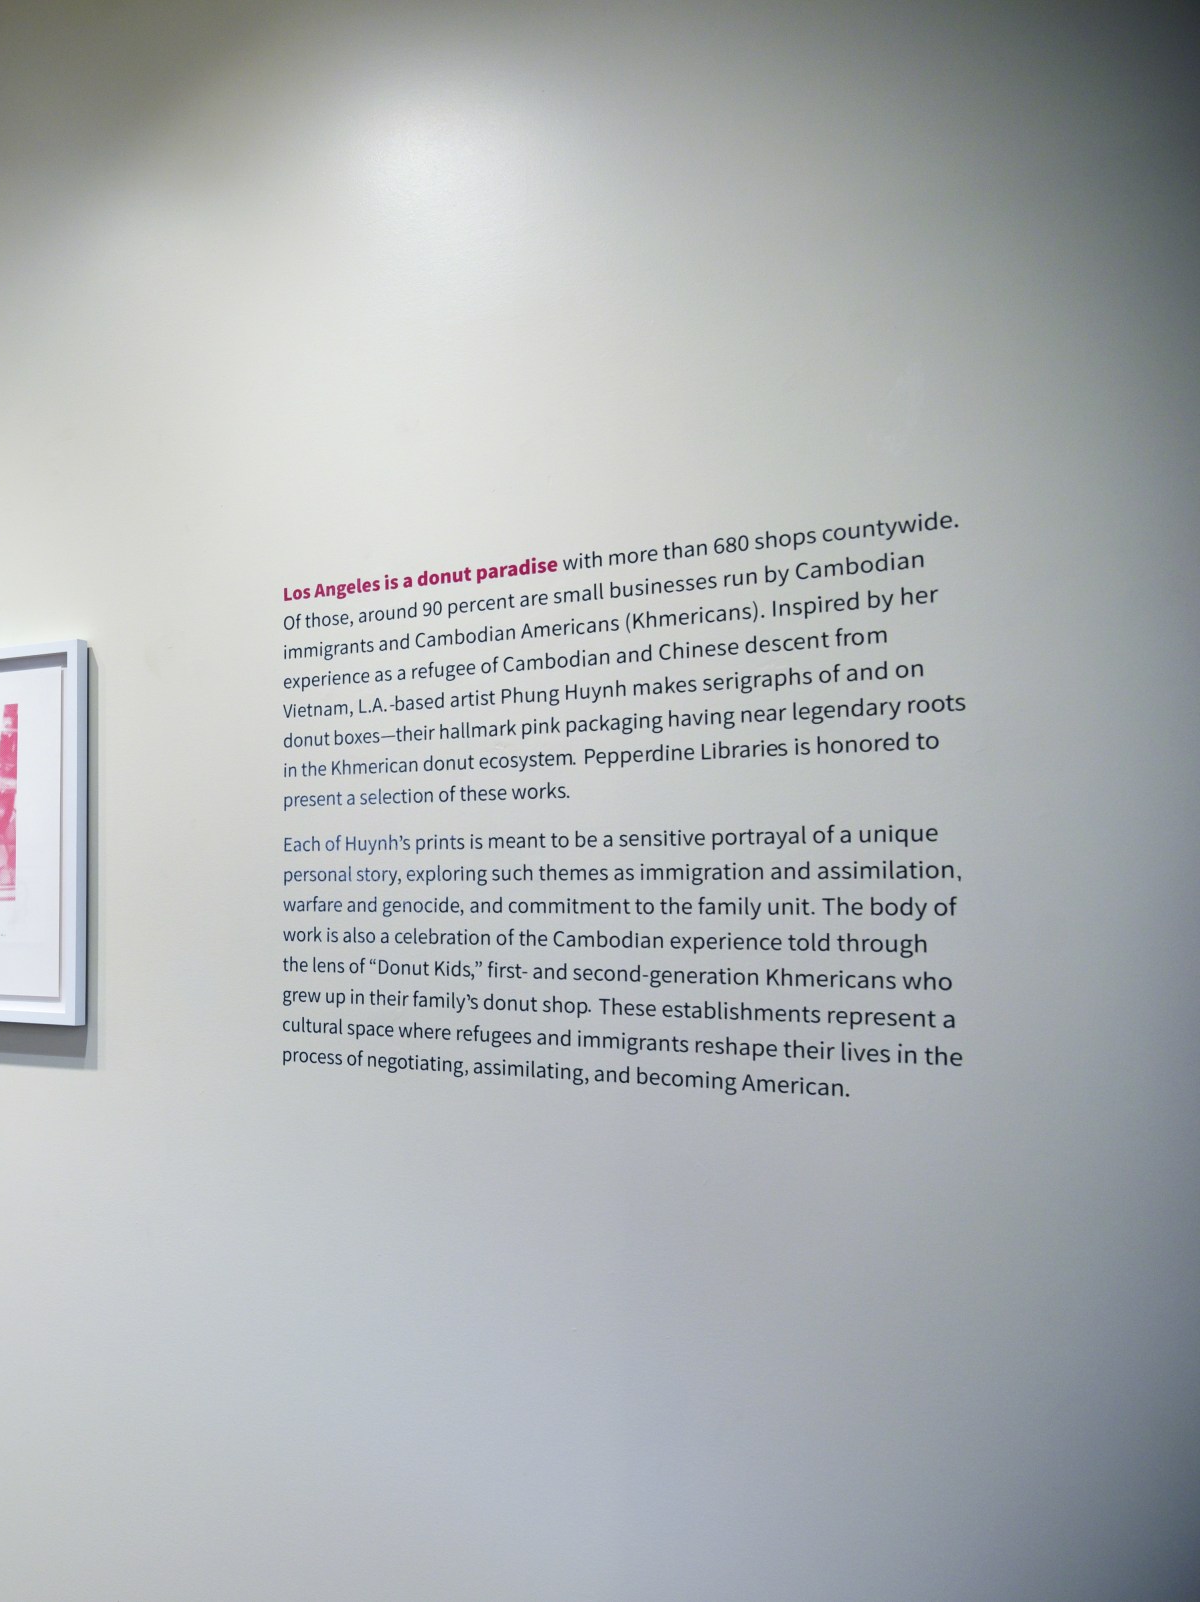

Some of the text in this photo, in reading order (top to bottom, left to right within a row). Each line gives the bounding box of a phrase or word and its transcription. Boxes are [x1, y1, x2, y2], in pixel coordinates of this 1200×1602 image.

[284, 511, 958, 602] Los Angeles donut paradise with more than 680 shops countywide.
[284, 552, 924, 630] Of those, around 90 percent are small businesses run by Cambodian
[284, 587, 938, 660] immigrants and Cambodian Americans (Khmericans). Inspired by her
[284, 628, 887, 692] experience as refugee of Cambodian and Chinese descent from
[283, 704, 353, 718] Vietnam,
[450, 690, 496, 708] artist
[502, 687, 560, 706] Phung
[566, 680, 626, 703] Huynh
[633, 676, 697, 696] makes
[703, 667, 812, 694] serigraphs
[819, 664, 840, 683] of
[846, 661, 888, 682] and
[896, 664, 924, 678] on
[284, 732, 330, 748] donut
[440, 719, 516, 740] hallmark
[522, 716, 560, 740] pink
[566, 713, 663, 738] packaging
[668, 709, 735, 729] having
[741, 708, 787, 723] near
[793, 698, 901, 724] legendary
[908, 695, 966, 714] roots
[301, 732, 939, 777] the Khmerican donut ecosystem. Pepperdine Libraries honored to
[284, 782, 570, 811] present selection of these works.
[284, 824, 938, 855] Each of Huynh’s prints meant to be sensitive portrayal of unique
[284, 860, 961, 886] personal story, exploring such themes as immigration and assimilation,
[283, 896, 957, 921] warfare and genocide, and commitment to the family unit. The body of
[283, 926, 927, 958] work also celebration of the Cambodian experience told through
[283, 956, 952, 991] the lens of “Donut Kids,” first- and second-generation Khmericans who
[283, 989, 936, 1030] grew up their family’s donut shop. These establishments represent
[283, 1016, 962, 1066] cultural space where refugees and immigrants reshape their lives in the
[283, 1050, 850, 1097] process of negotiating, assimilating, and becoming American.
